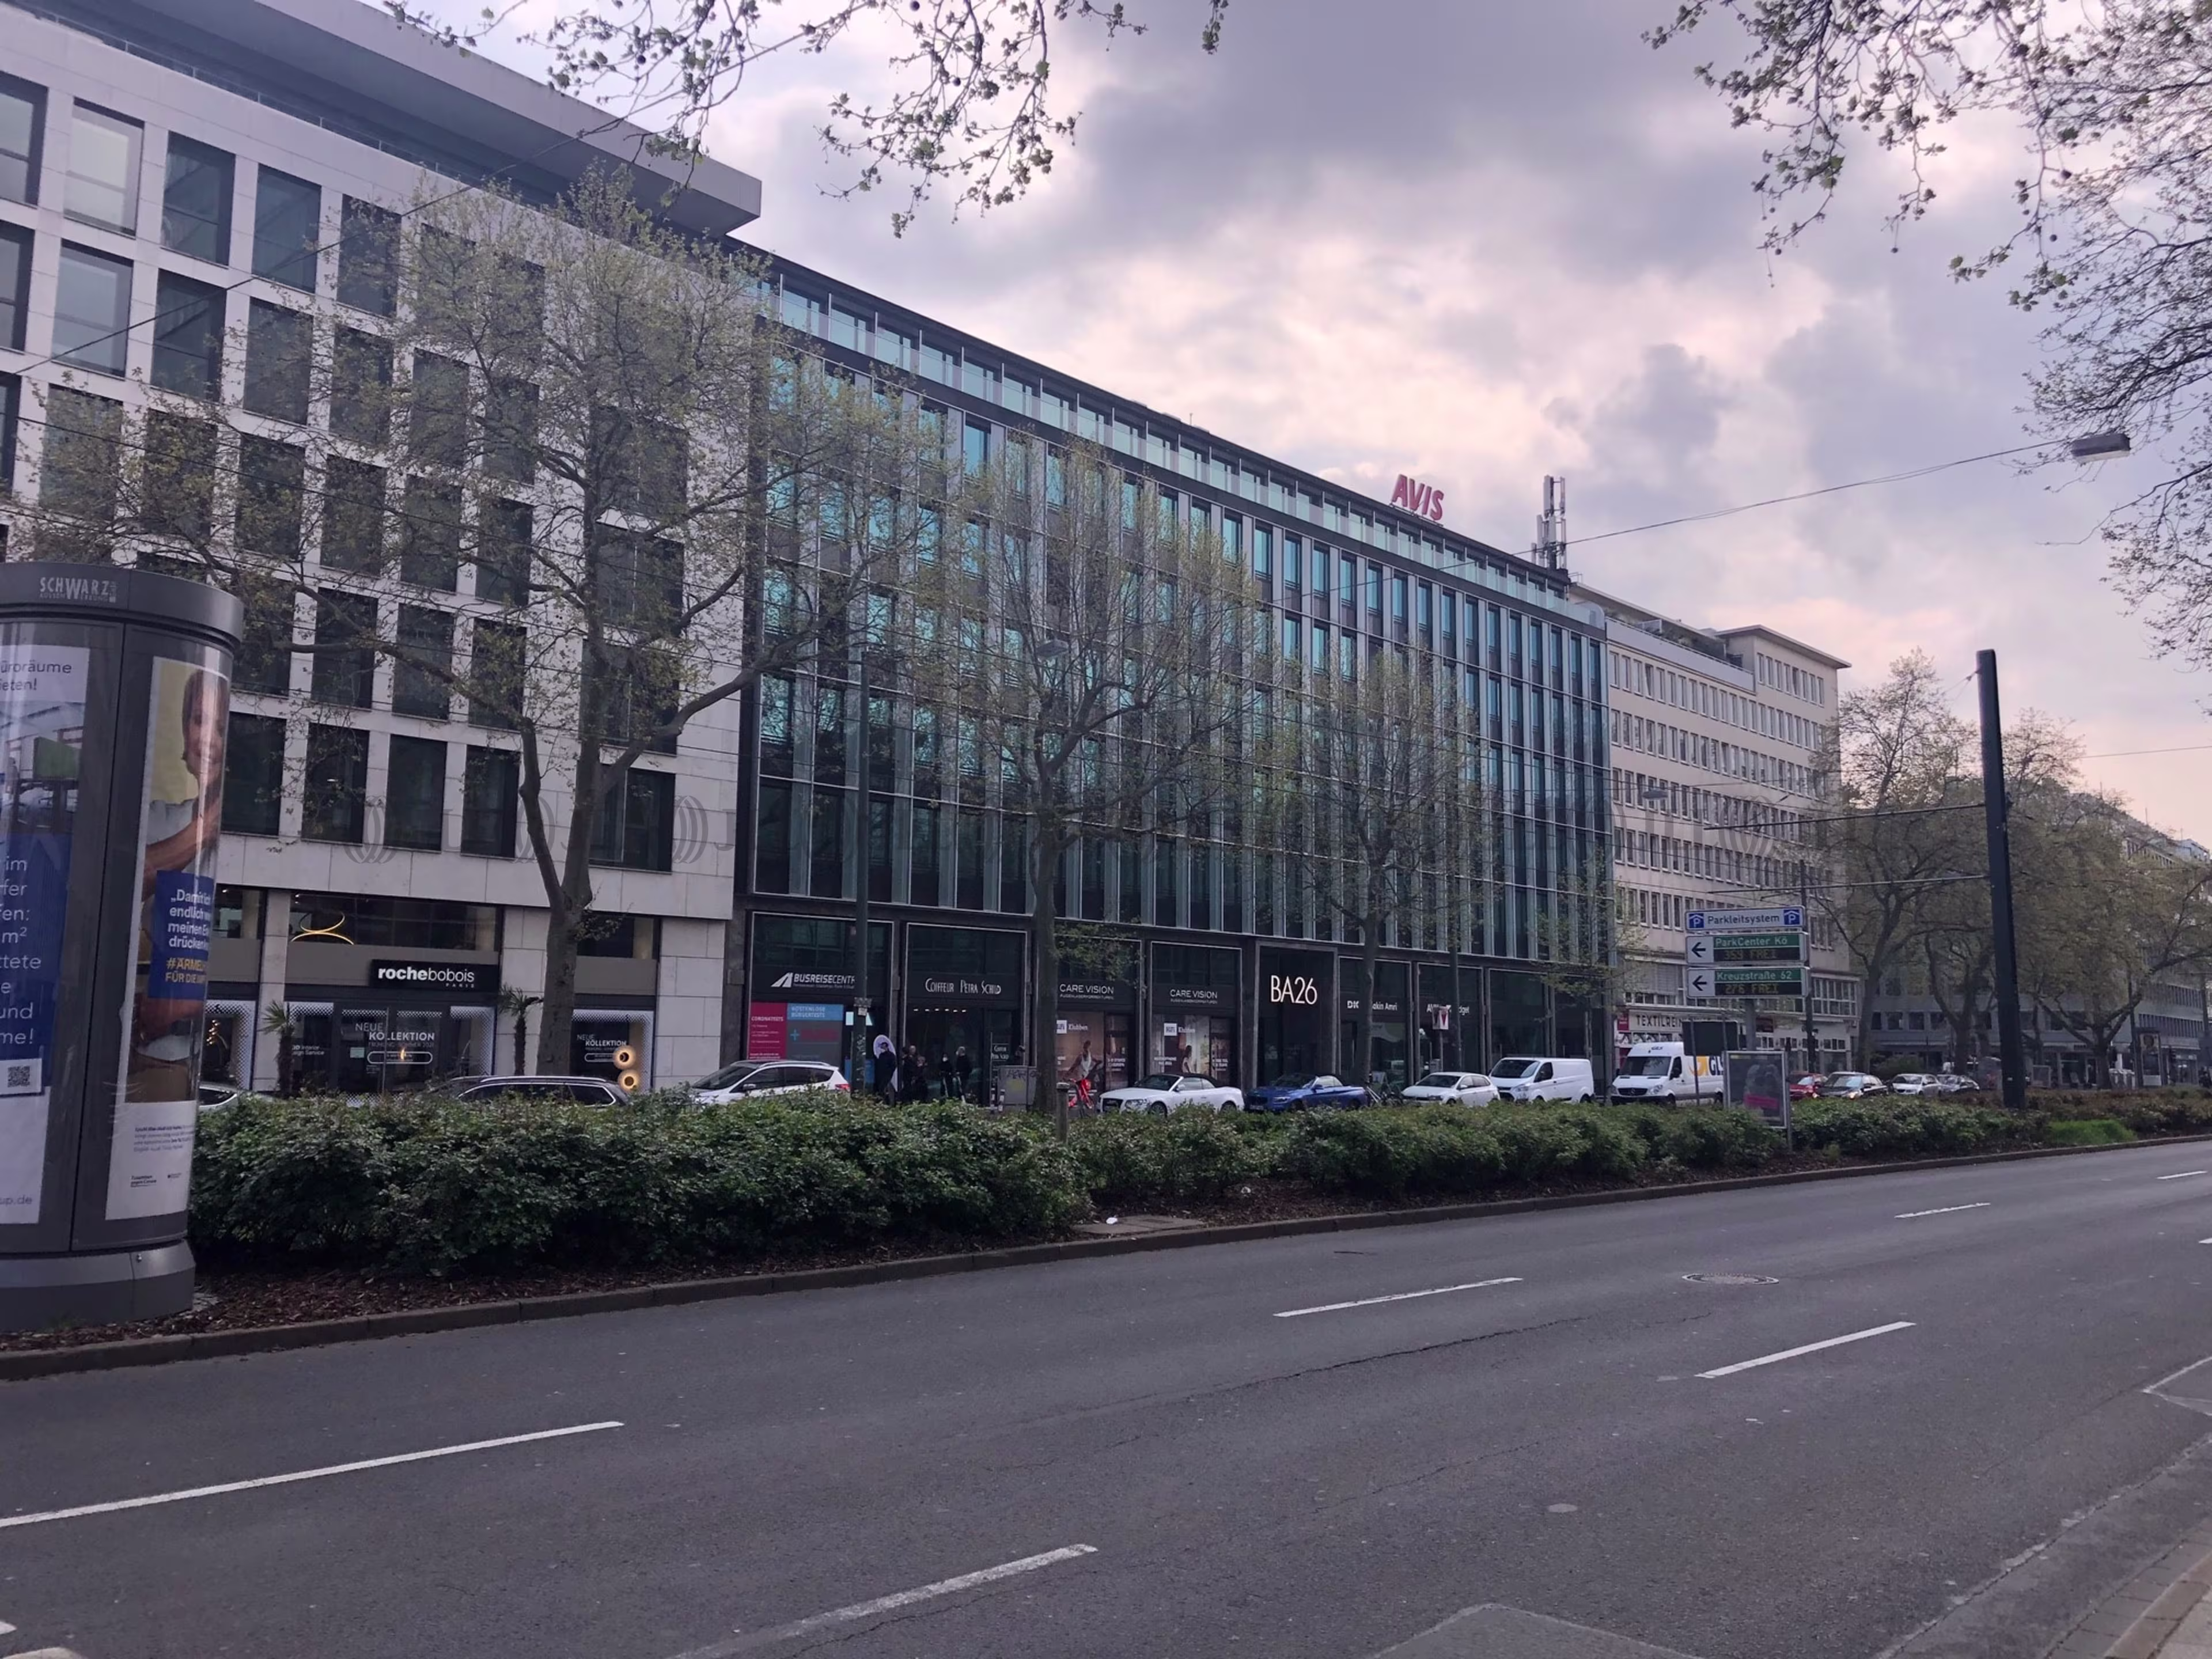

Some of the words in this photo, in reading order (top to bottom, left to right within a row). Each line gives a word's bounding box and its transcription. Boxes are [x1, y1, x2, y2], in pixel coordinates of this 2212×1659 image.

[1391, 474, 1444, 521] AVIS
[40, 577, 109, 600] SCHWARZ
[6, 855, 28, 872] im
[1707, 915, 1780, 925] Parkleitsystem
[1715, 937, 1771, 947] ParkCenter
[1774, 936, 1788, 945] Kö
[1750, 949, 1777, 959] FREI
[378, 967, 475, 983] rochebobois
[1717, 971, 1777, 980] Kreuzstraße
[1781, 970, 1792, 980] 62
[1059, 983, 1084, 993] CARE
[1085, 986, 1114, 994] VISION
[1169, 989, 1191, 998] CARE
[1192, 990, 1218, 999] VISION
[1271, 975, 1317, 1005] BA26
[1725, 984, 1745, 994] 276
[1752, 983, 1779, 994] FREI
[1372, 1001, 1384, 1010] akin
[355, 1022, 383, 1032] NEUE
